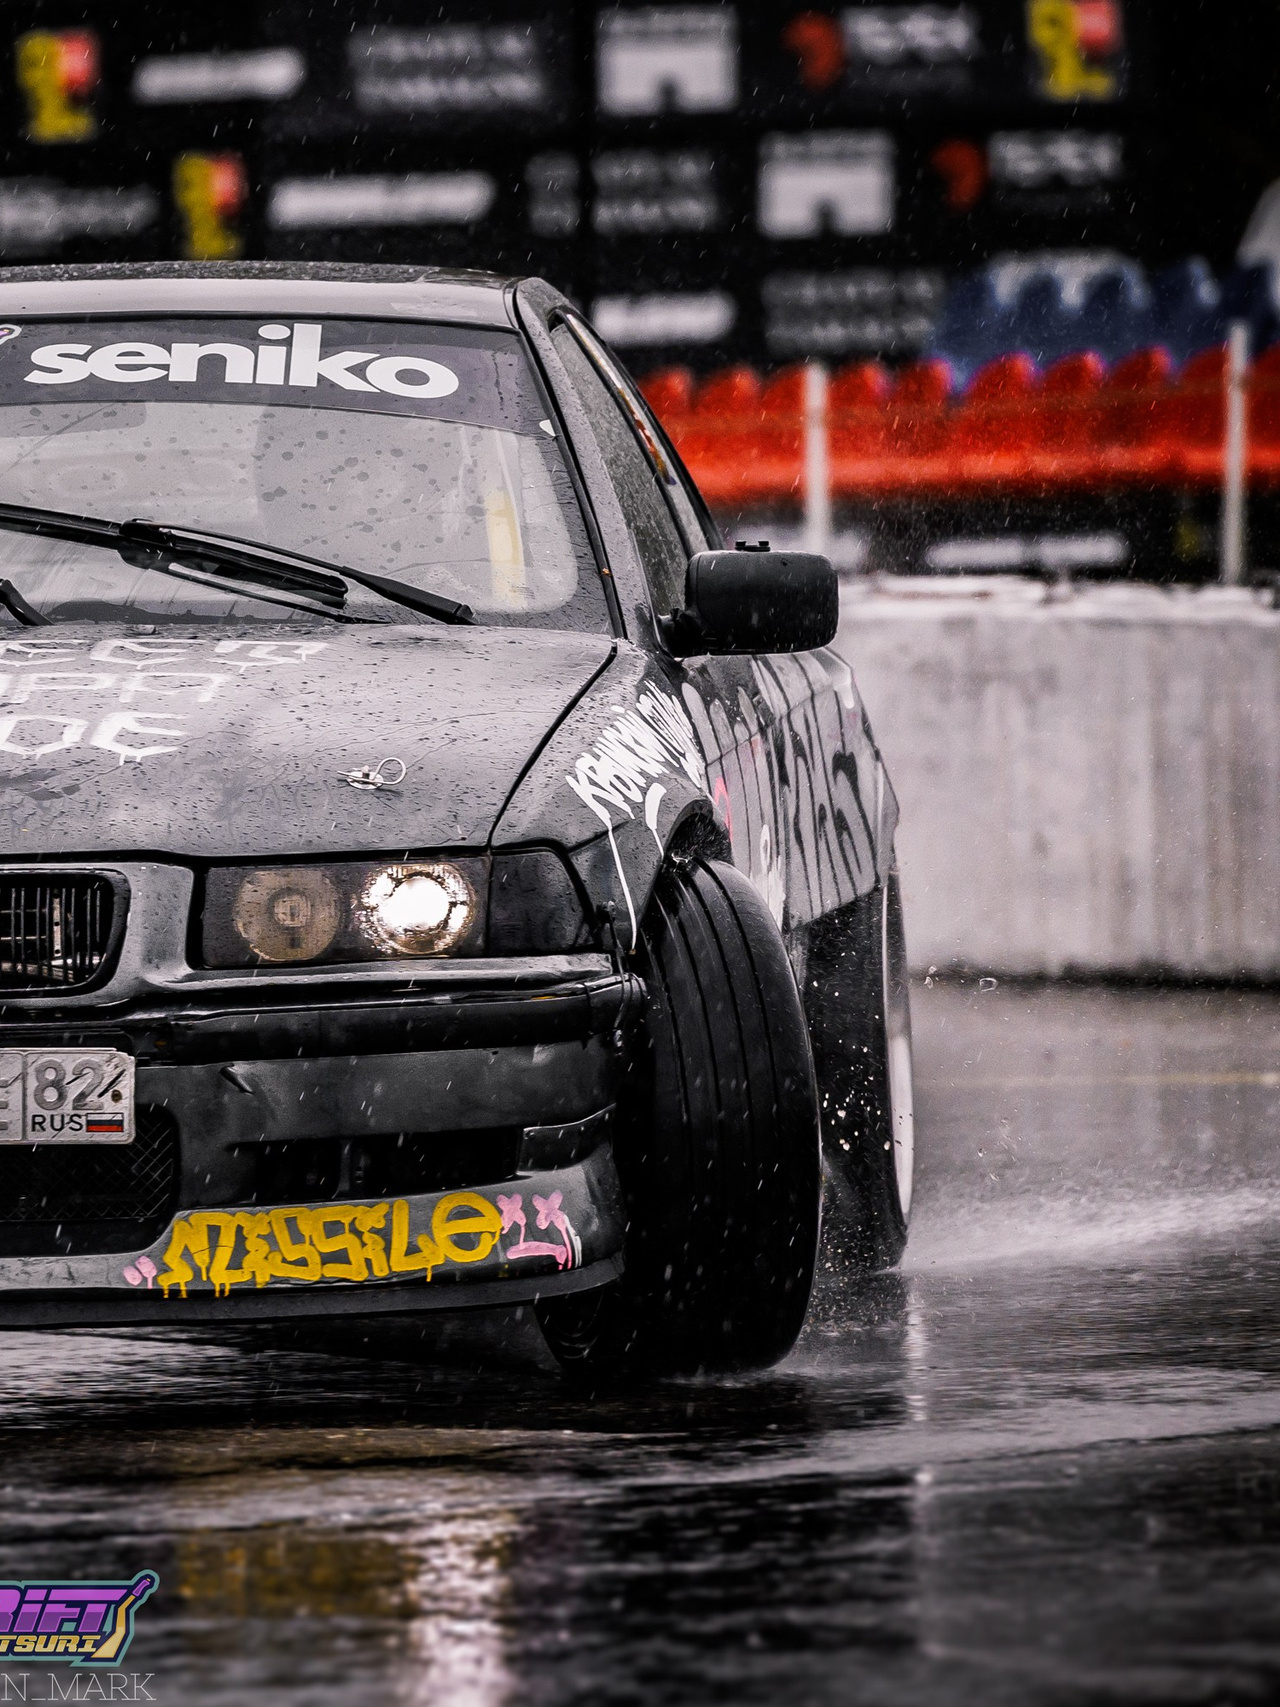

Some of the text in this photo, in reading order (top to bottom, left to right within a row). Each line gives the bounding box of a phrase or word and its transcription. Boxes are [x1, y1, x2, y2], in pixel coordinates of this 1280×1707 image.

[23, 323, 459, 398] seniko
[33, 1058, 104, 1111] 82
[31, 1114, 83, 1132] RUS
